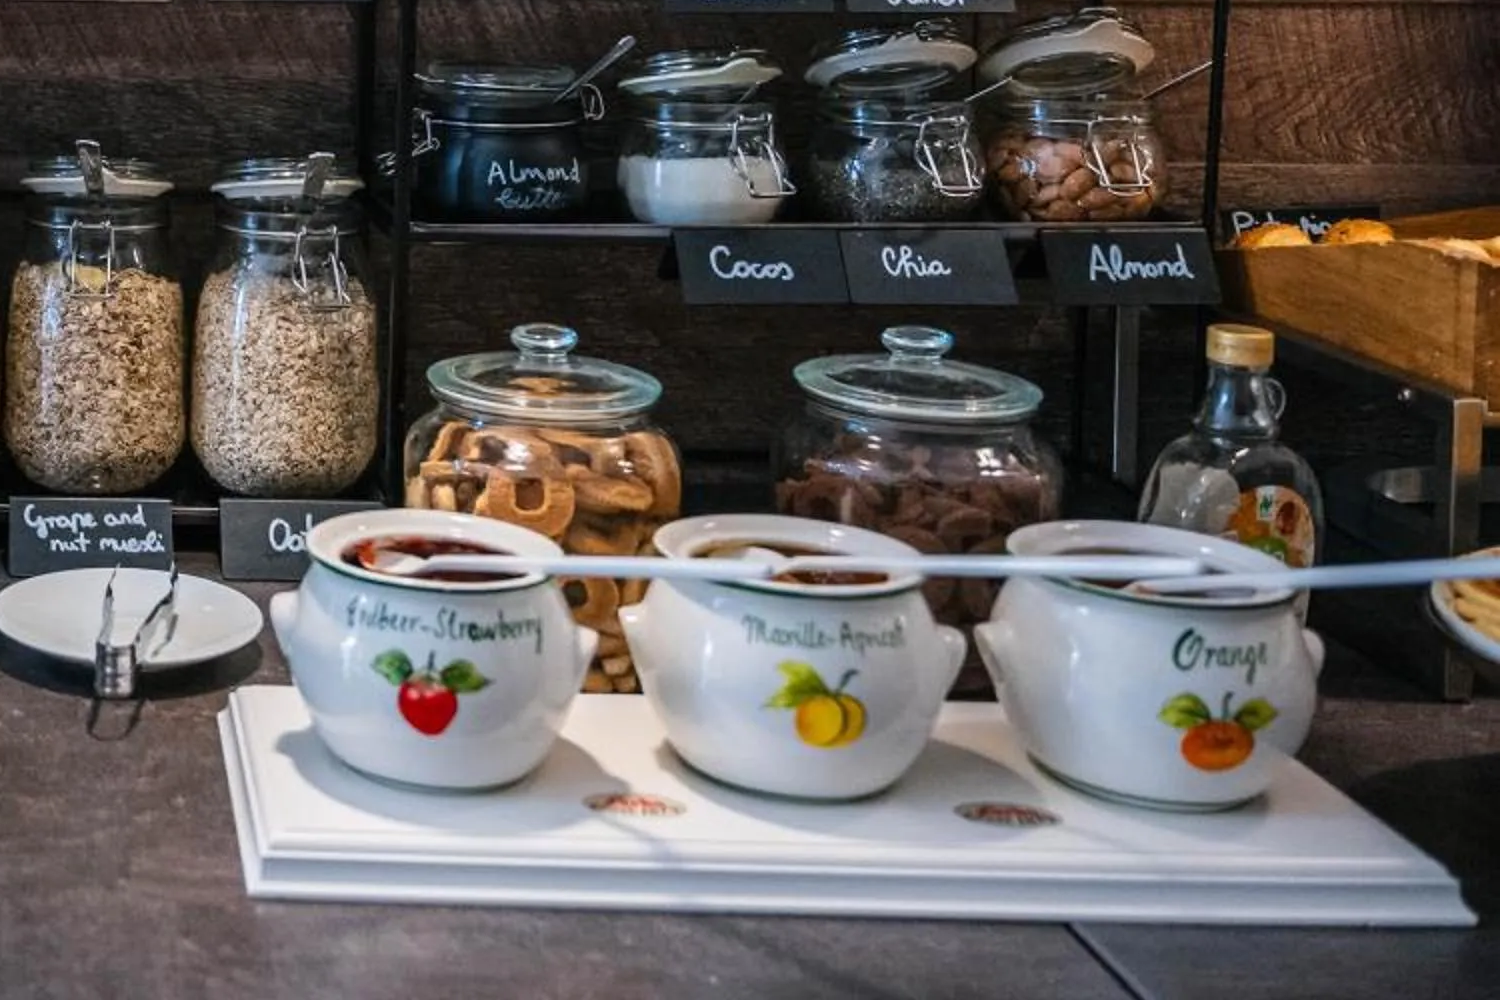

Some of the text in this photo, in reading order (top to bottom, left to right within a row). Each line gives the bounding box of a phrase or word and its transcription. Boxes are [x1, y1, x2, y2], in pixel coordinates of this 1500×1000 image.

[487, 156, 581, 185] Almond
[709, 245, 794, 281] Cocos
[882, 245, 952, 278] Chia
[1089, 243, 1195, 281] Almond
[23, 503, 148, 538] Grape and
[50, 530, 166, 553] nut muesli
[1172, 628, 1268, 686] Orange
